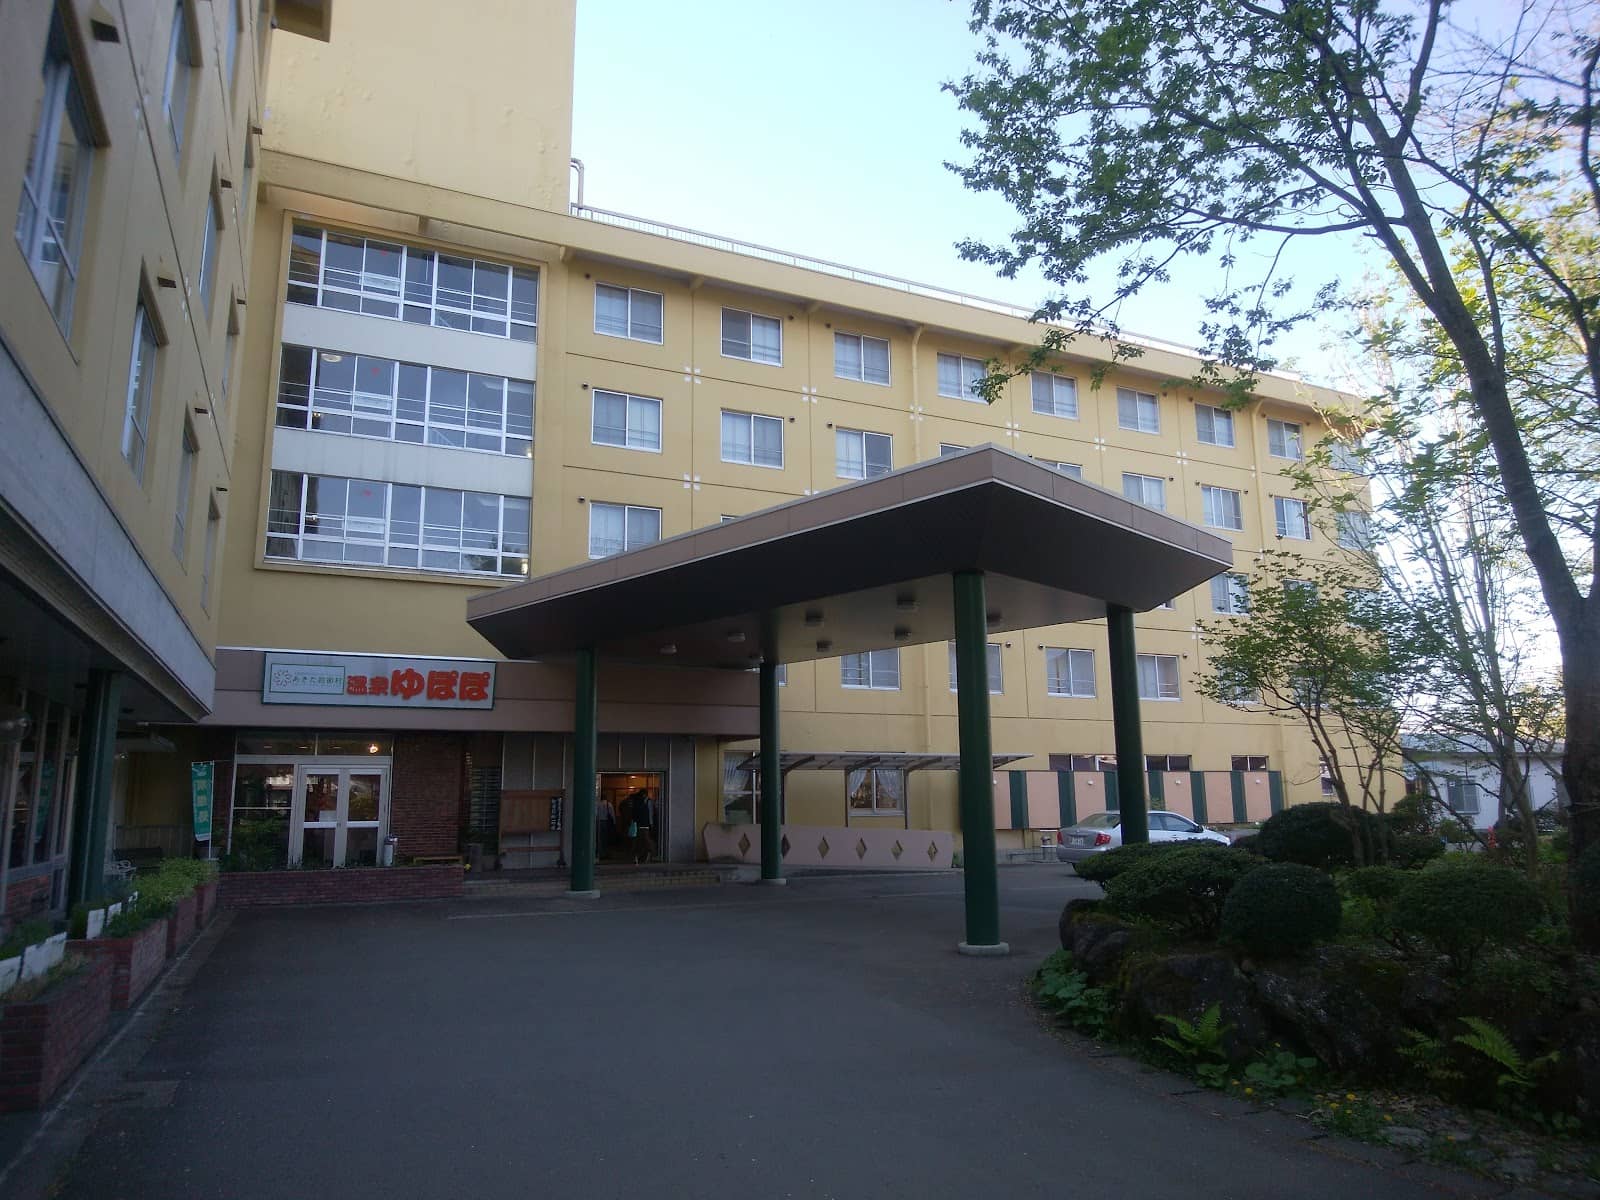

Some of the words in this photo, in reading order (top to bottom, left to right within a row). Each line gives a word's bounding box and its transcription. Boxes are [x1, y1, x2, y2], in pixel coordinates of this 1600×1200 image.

[347, 668, 491, 701] 温泉ゆぽぽ
